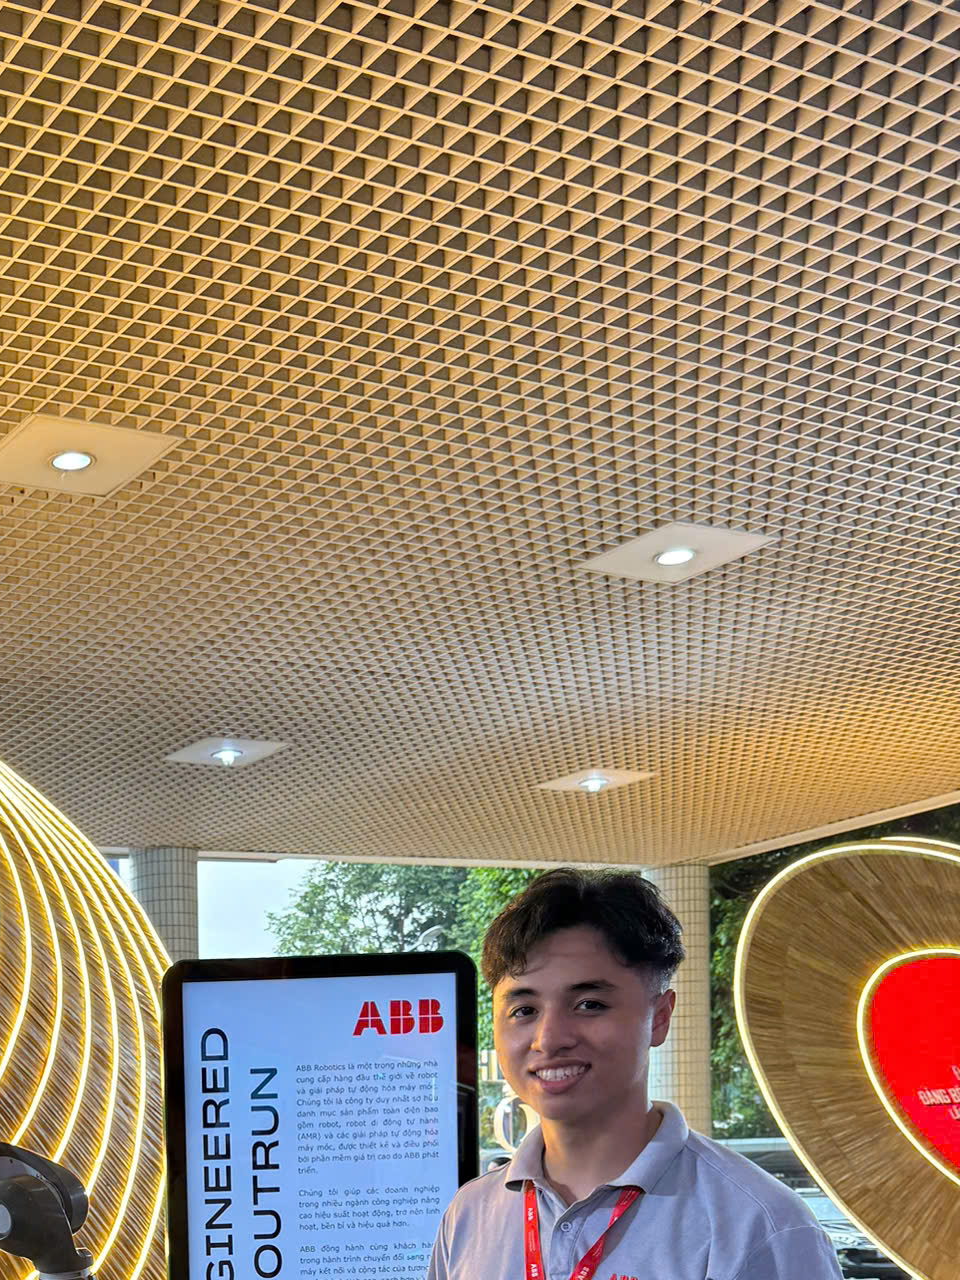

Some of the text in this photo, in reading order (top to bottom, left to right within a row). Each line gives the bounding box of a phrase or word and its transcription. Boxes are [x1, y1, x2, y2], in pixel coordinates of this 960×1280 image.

[352, 998, 444, 1036] ABB
[357, 1063, 372, 1071] một
[374, 1063, 394, 1071] trong
[334, 1074, 352, 1082] hàng
[360, 1085, 378, 1093] động
[296, 1099, 320, 1107] Chúng
[324, 1097, 333, 1105] tôi
[345, 1097, 363, 1105] công
[376, 1096, 389, 1104] duy
[297, 1132, 321, 1140] (AMR)
[298, 1144, 313, 1152] máy
[249, 1068, 283, 1279] OUTRUN
[299, 1189, 322, 1197] Chúng
